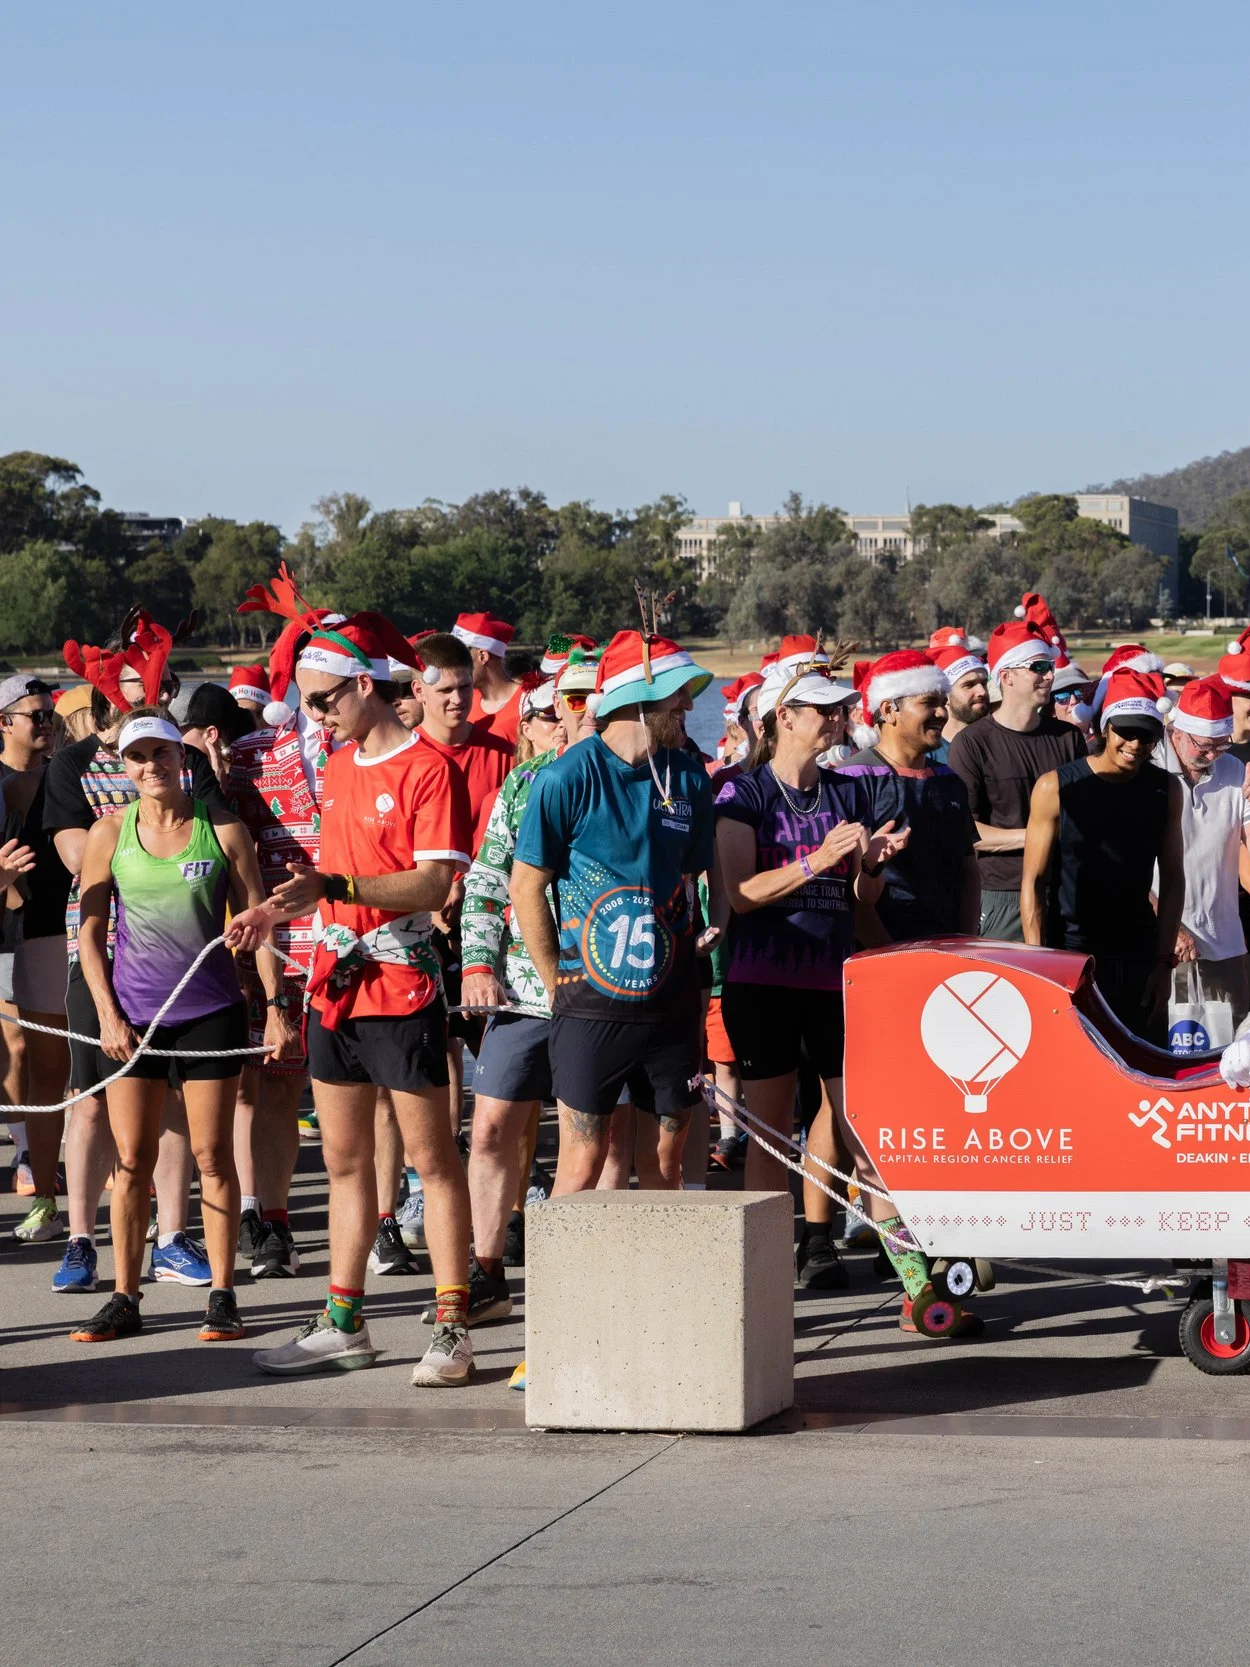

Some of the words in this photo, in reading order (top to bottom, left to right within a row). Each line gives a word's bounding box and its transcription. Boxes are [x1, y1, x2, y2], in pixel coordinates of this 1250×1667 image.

[183, 861, 210, 877] FIT
[600, 897, 624, 916] 2008
[632, 896, 654, 906] 2023
[608, 914, 656, 969] 15
[624, 974, 658, 988] YEARS
[1171, 1031, 1205, 1047] ABC
[879, 1127, 946, 1150] RISE
[963, 1127, 1074, 1150] ABOVE
[879, 1154, 928, 1163] CAPITAL
[933, 1154, 979, 1164] REGION
[983, 1155, 1031, 1164] CANCER
[1036, 1155, 1074, 1164] RELIEF
[1176, 1153, 1229, 1164] DEAKIN
[1020, 1211, 1092, 1232] JUST
[1158, 1211, 1231, 1232] KEEP
